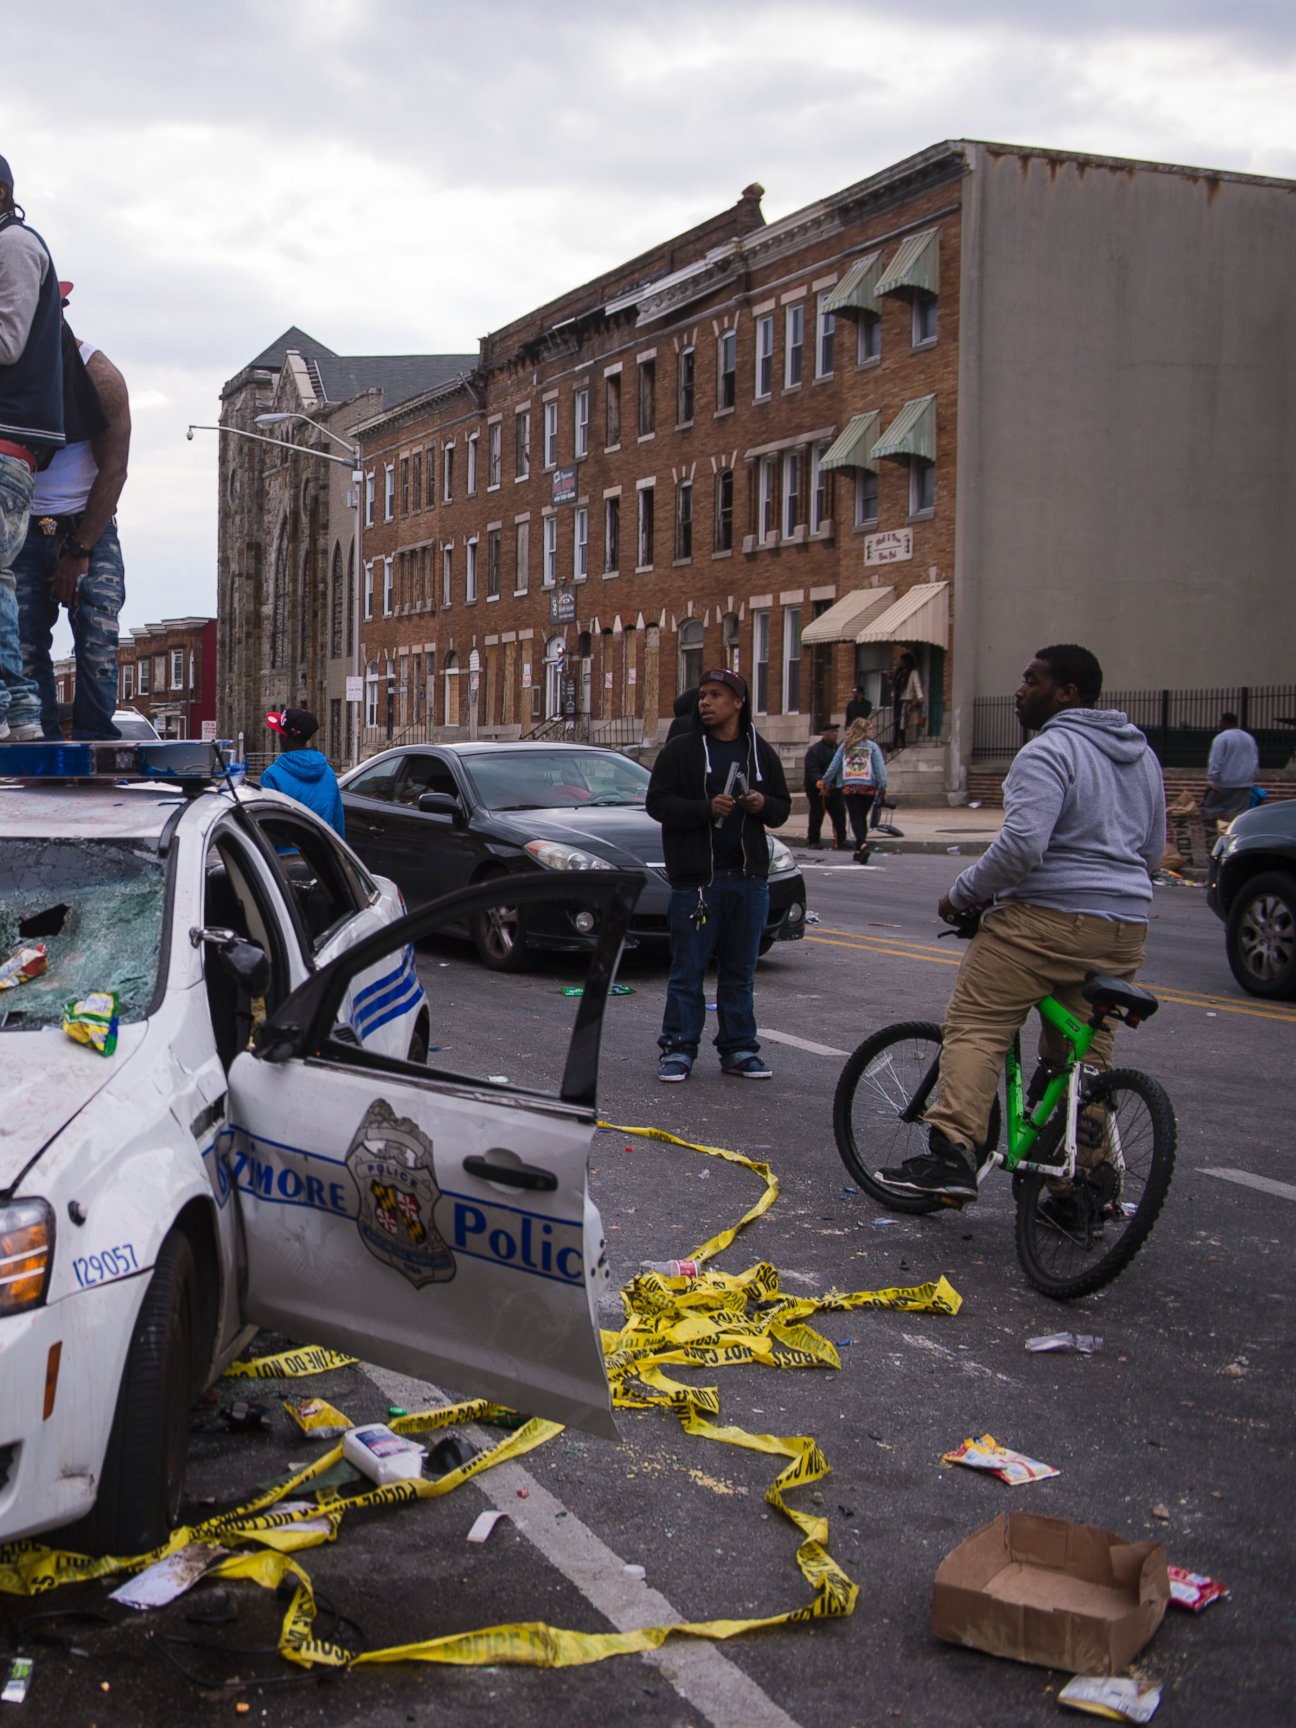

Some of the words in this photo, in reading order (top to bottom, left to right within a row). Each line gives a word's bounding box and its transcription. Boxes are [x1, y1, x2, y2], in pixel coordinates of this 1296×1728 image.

[367, 1164, 418, 1189] POLICE
[455, 1202, 582, 1279] Polic
[72, 1244, 139, 1287] 129057
[284, 1355, 308, 1374] DO
